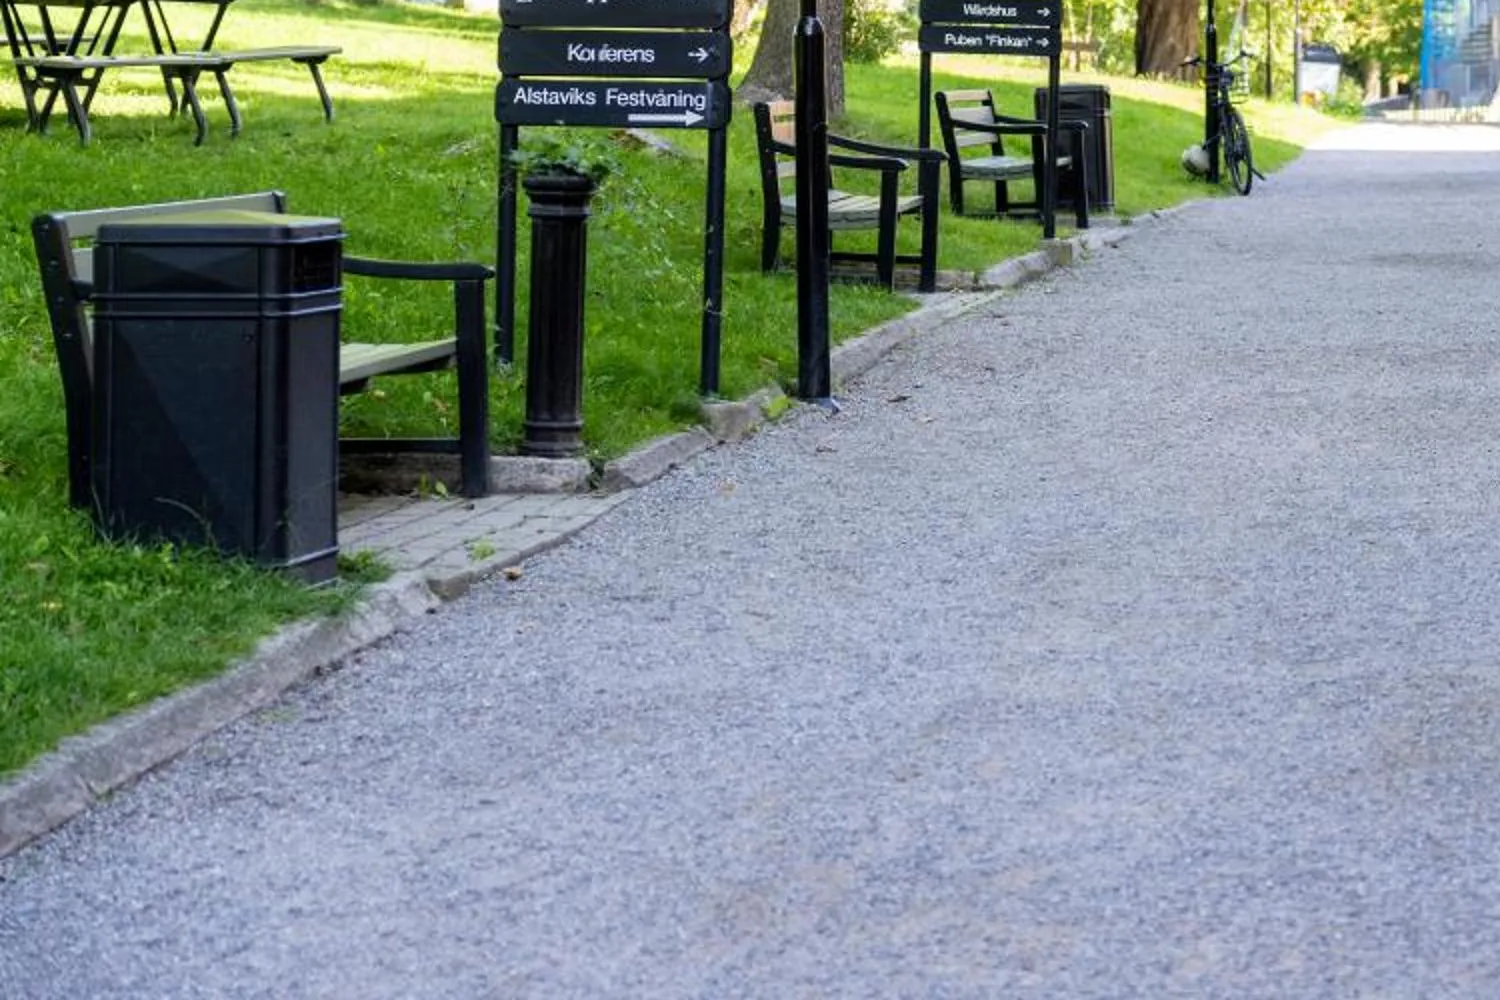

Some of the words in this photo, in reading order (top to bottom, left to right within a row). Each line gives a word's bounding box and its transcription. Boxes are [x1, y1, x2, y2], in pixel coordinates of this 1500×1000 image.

[945, 33, 983, 46] Puben
[513, 87, 597, 105] Alstaviks
[605, 88, 707, 111] Festvåning
